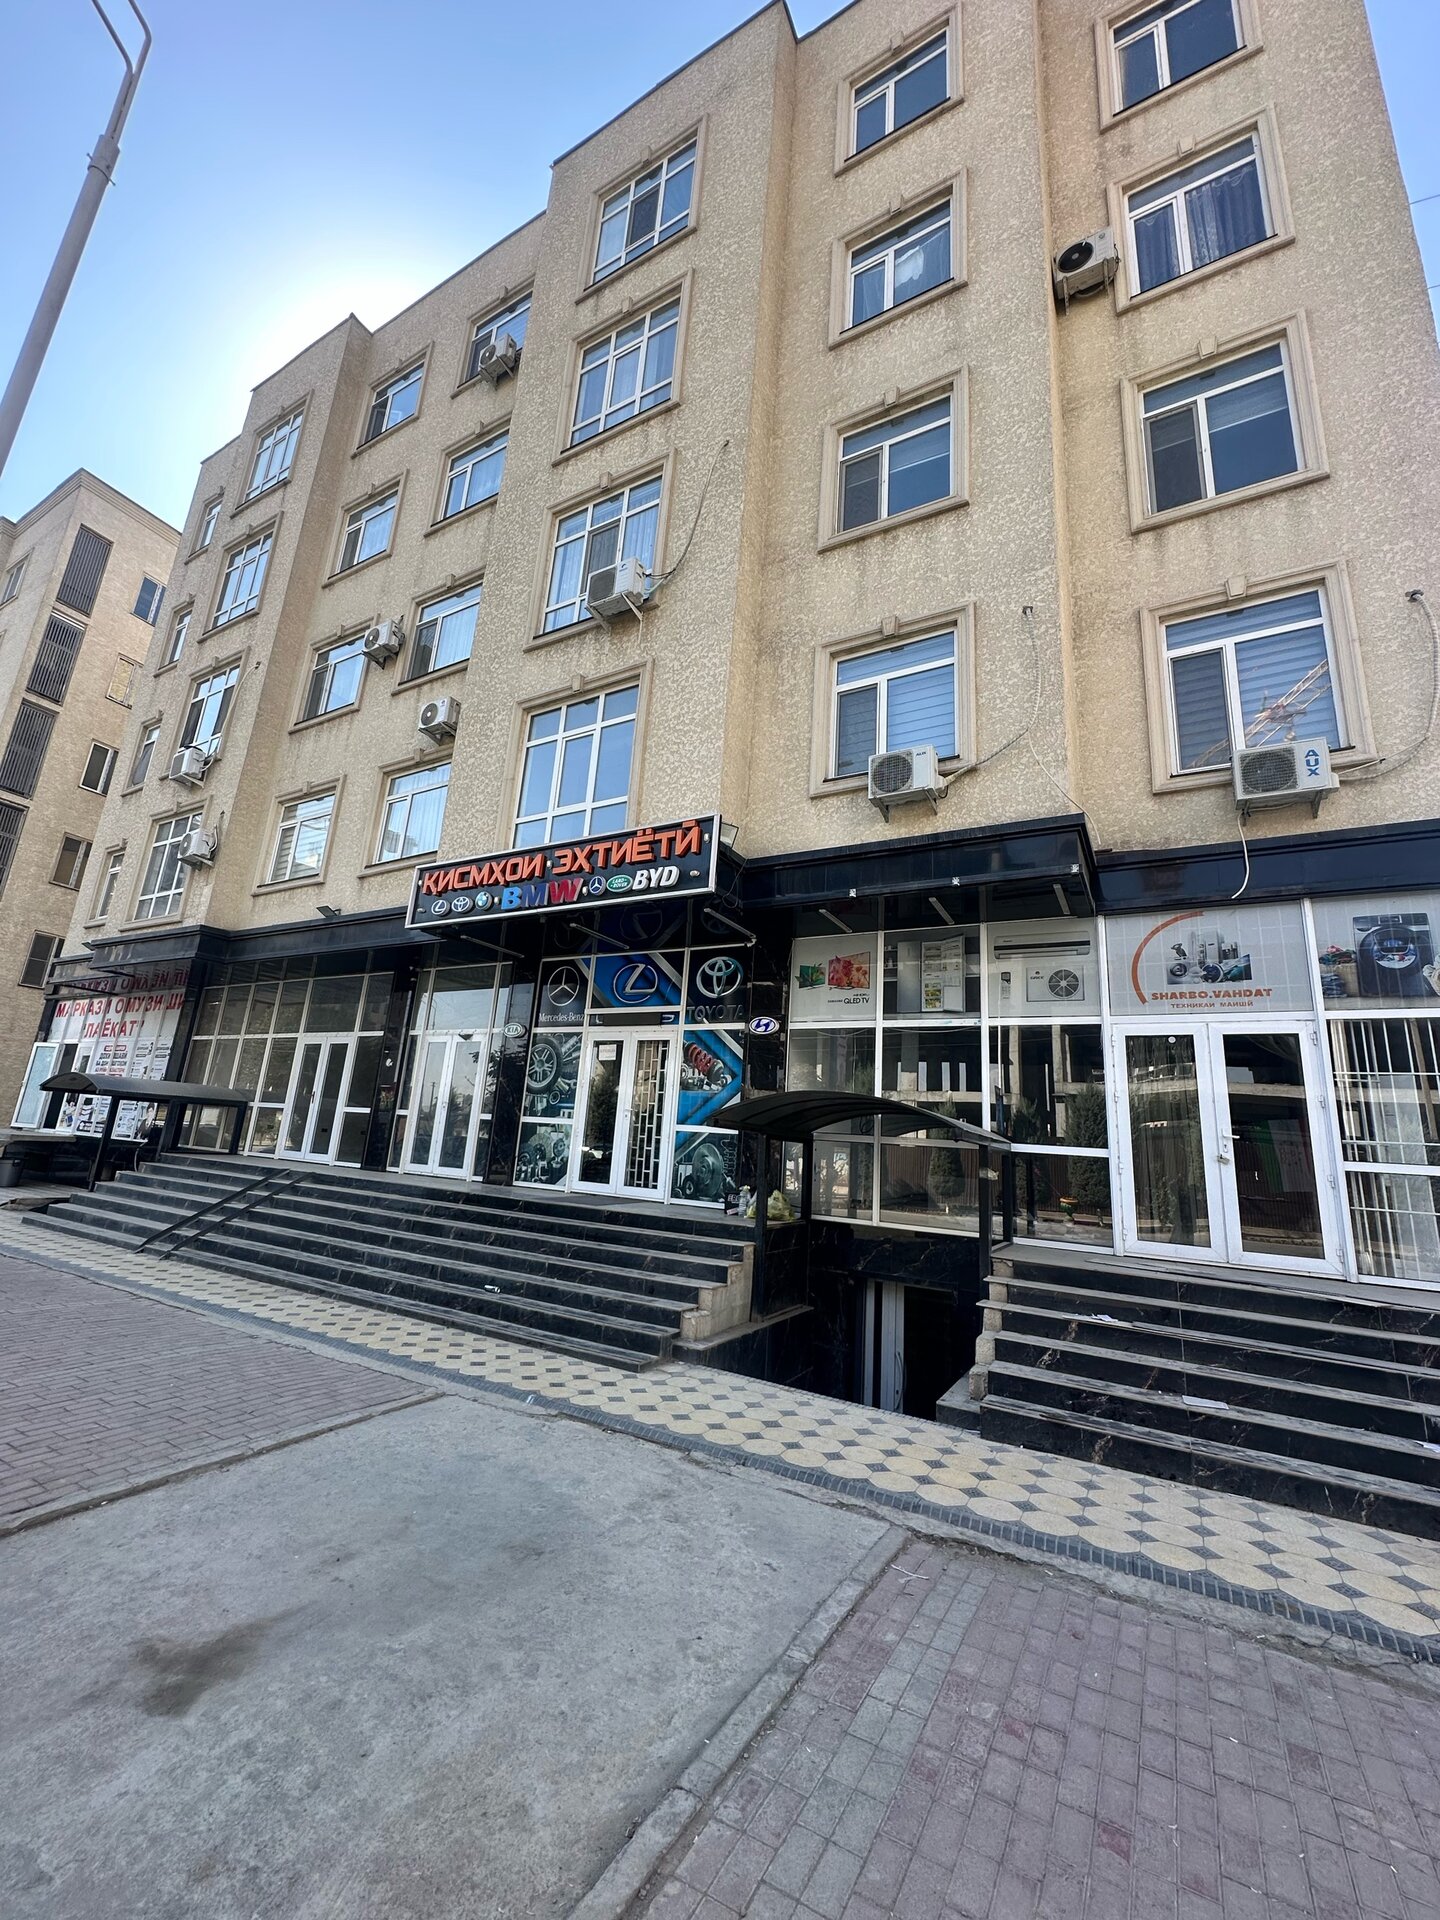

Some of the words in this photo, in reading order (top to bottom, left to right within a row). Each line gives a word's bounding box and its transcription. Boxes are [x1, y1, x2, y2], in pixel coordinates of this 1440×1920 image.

[1305, 749, 1320, 777] AUX
[421, 853, 545, 895] ҚИСМҲОИ
[632, 865, 680, 891] BYD
[501, 876, 584, 910] BMW
[1151, 988, 1272, 1000] SHARBO.VAHDAT
[538, 1012, 584, 1022] Mercedes-Benz
[687, 1004, 744, 1022] TOYOTA
[506, 1026, 520, 1034] KIA
